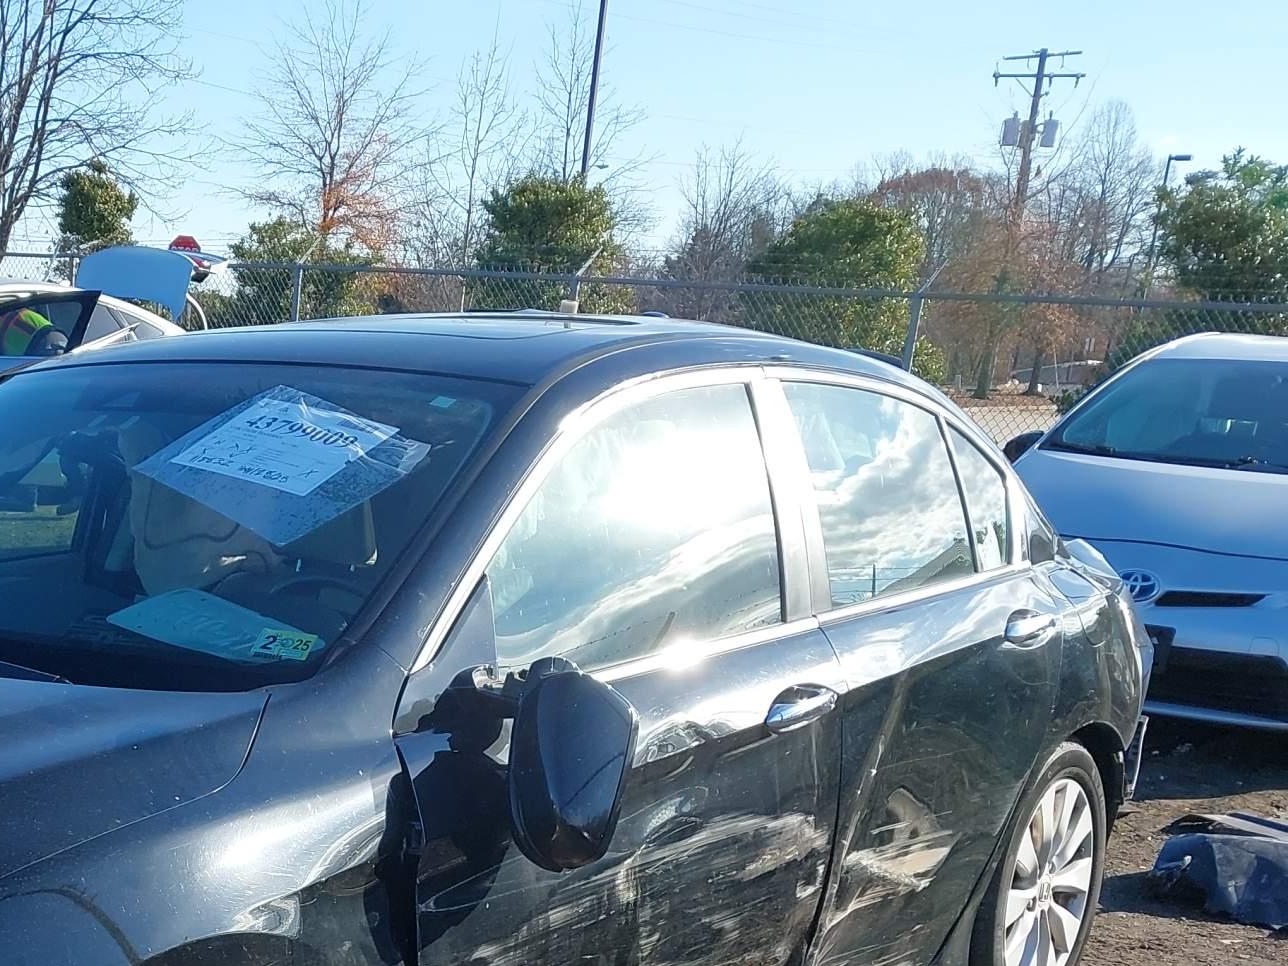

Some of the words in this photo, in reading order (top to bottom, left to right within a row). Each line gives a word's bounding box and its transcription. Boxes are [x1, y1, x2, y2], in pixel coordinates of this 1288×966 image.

[245, 415, 358, 448] 43799009
[259, 635, 278, 650] 2
[292, 639, 313, 651] 25
